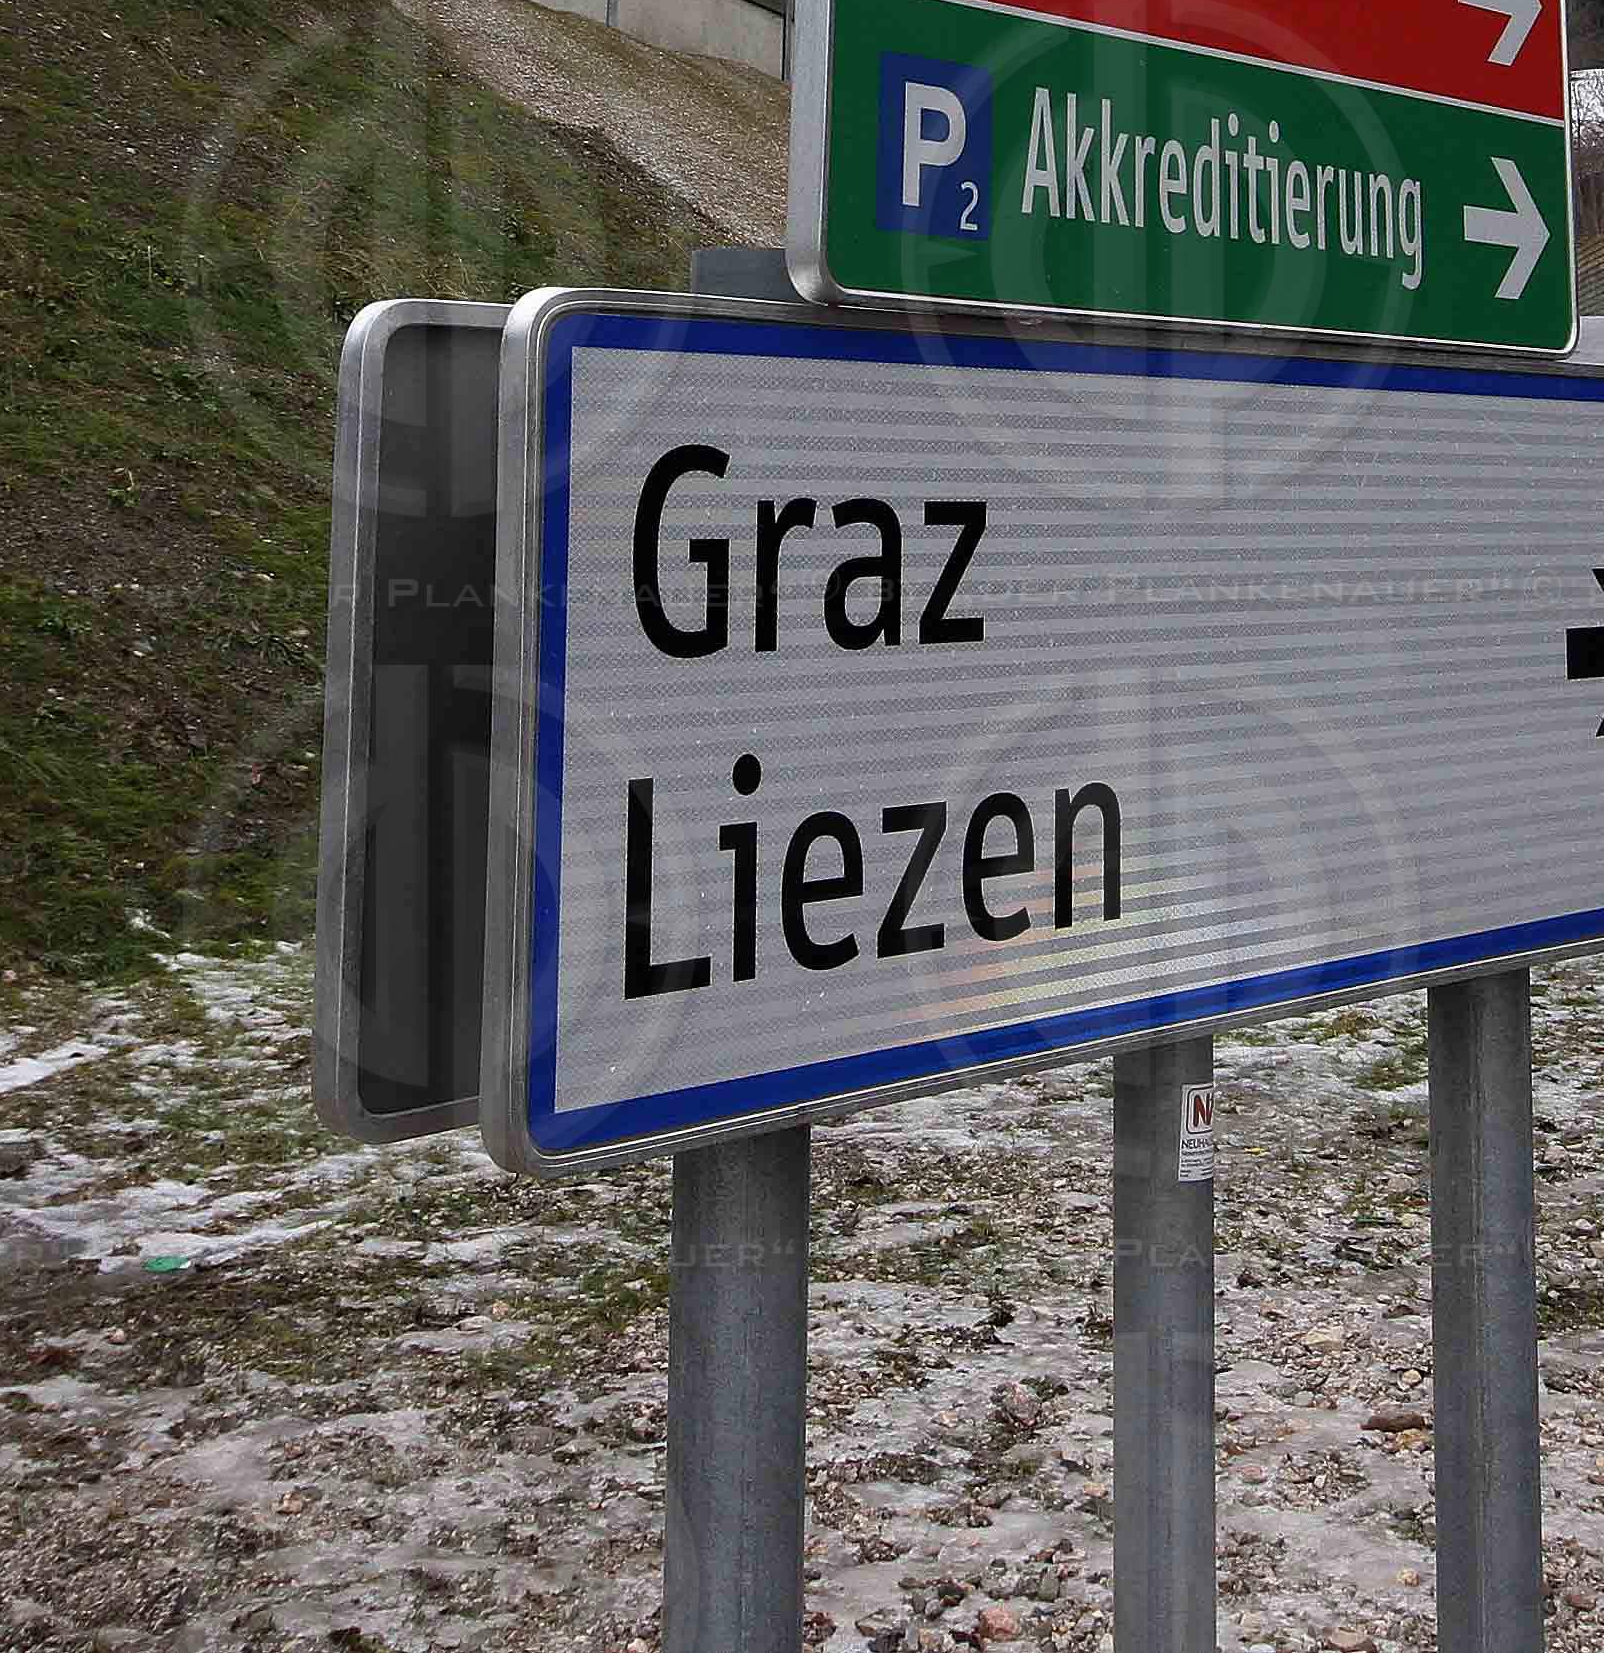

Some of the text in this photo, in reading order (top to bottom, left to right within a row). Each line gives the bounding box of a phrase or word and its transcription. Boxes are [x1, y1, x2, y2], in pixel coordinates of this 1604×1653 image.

[1021, 86, 1424, 290] Akkreditierung
[630, 442, 989, 660] Graz
[624, 754, 1123, 1002] Liezen
